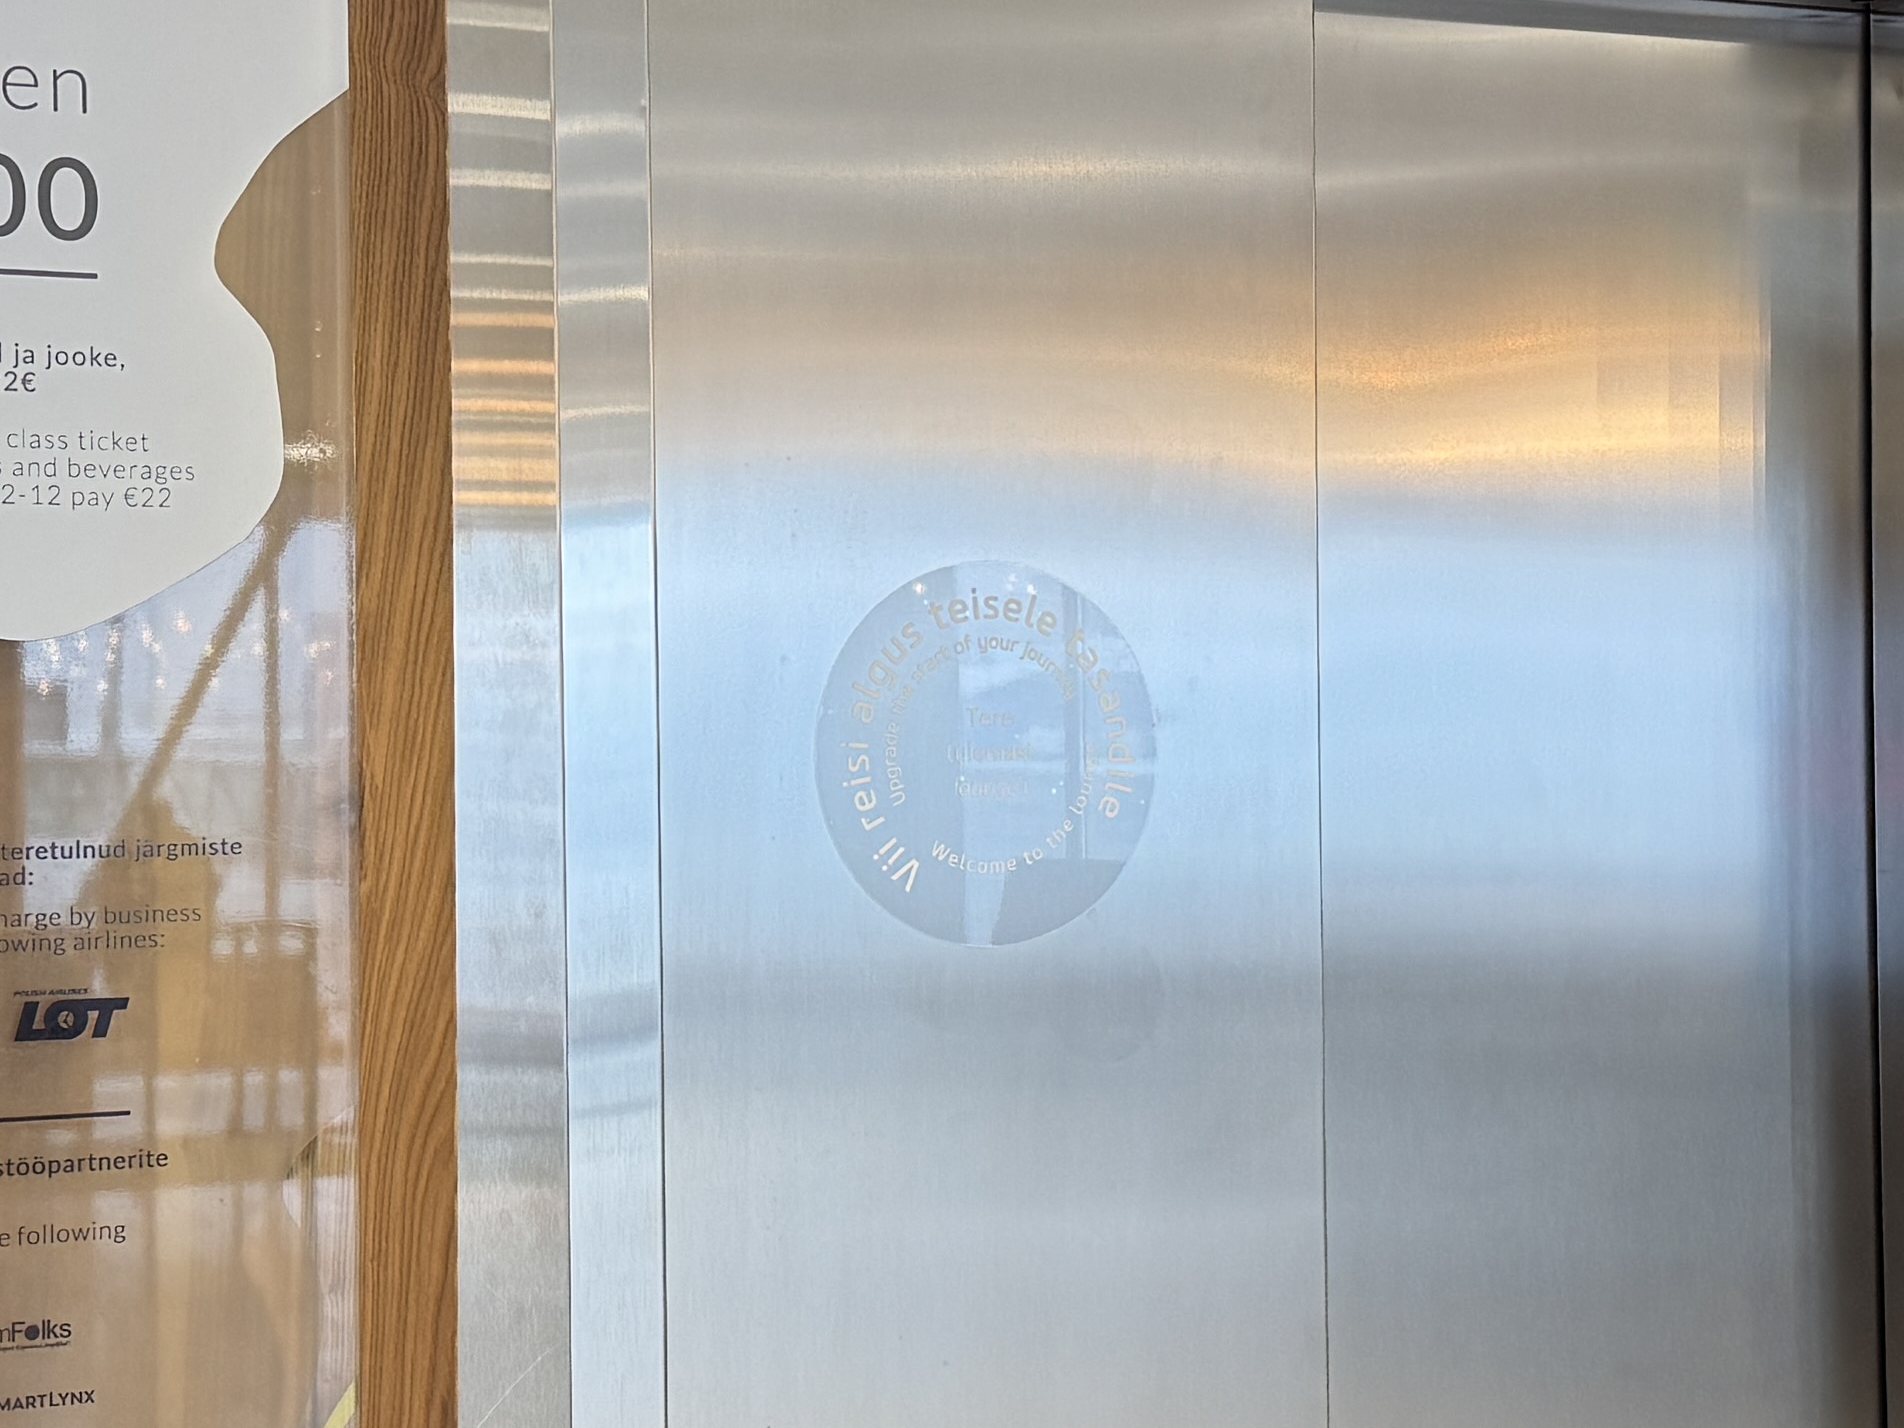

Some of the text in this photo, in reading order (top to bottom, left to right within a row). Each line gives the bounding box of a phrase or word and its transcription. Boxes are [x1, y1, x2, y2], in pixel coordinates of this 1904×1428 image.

[12, 342, 36, 370] ja
[45, 341, 126, 374] jooke,
[6, 423, 69, 451] class
[78, 428, 149, 455] ticket
[12, 454, 57, 481] and
[66, 455, 196, 486] beverages
[0, 485, 61, 508] 2-12
[70, 490, 114, 514] pay
[123, 485, 171, 510] €22
[928, 587, 1058, 637] teisele
[851, 620, 924, 725] algus
[879, 723, 905, 806] Upgrade
[953, 635, 972, 655] of
[977, 635, 1019, 653] your
[841, 741, 885, 830] reisi
[1, 839, 125, 861] teretulnud
[134, 837, 242, 862] järgmiste
[931, 840, 1017, 874] Welcome
[1024, 848, 1043, 865] to
[1046, 818, 1074, 849] the
[70, 904, 96, 930] by
[104, 904, 201, 925] business
[73, 930, 165, 951] airlines:
[14, 997, 130, 1042] LOT
[18, 1221, 126, 1246] following
